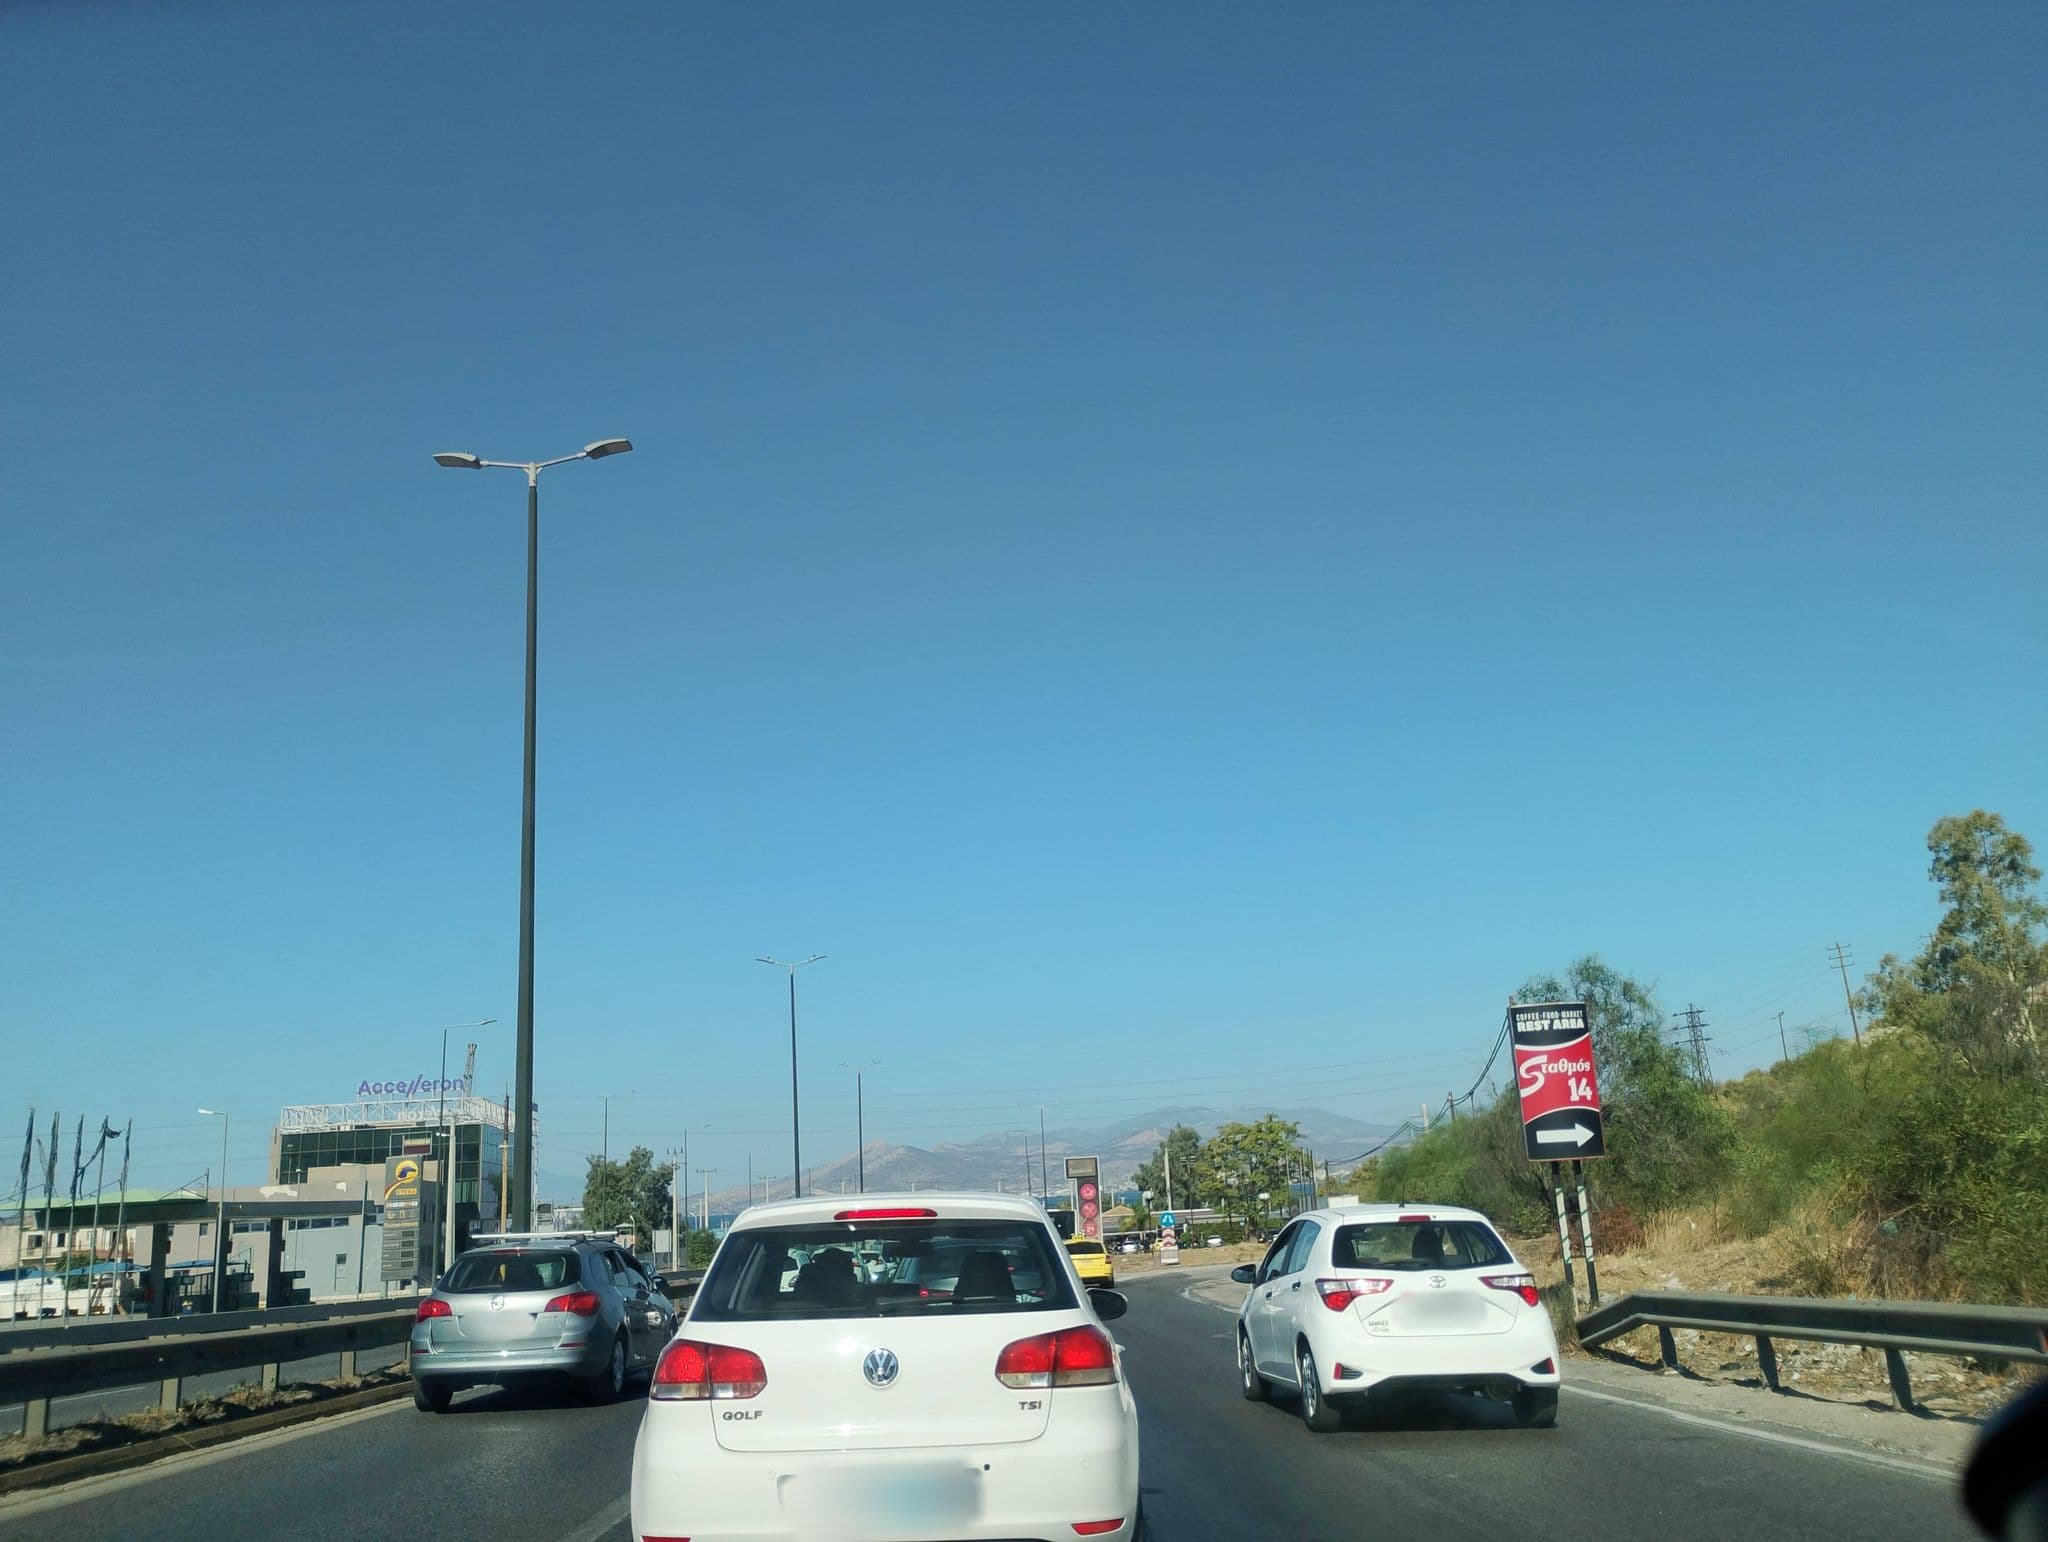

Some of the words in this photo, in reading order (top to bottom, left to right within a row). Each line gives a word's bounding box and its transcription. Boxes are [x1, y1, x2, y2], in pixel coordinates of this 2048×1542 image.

[1516, 1012, 1539, 1021] COFFEE
[1542, 1011, 1559, 1019] FOOD
[1561, 1010, 1583, 1018] MARKET
[1517, 1020, 1550, 1031] REST
[1553, 1018, 1584, 1029] AREA
[1568, 1077, 1593, 1102] 14
[1018, 1400, 1042, 1411] TSI
[722, 1410, 763, 1421] GOLF
